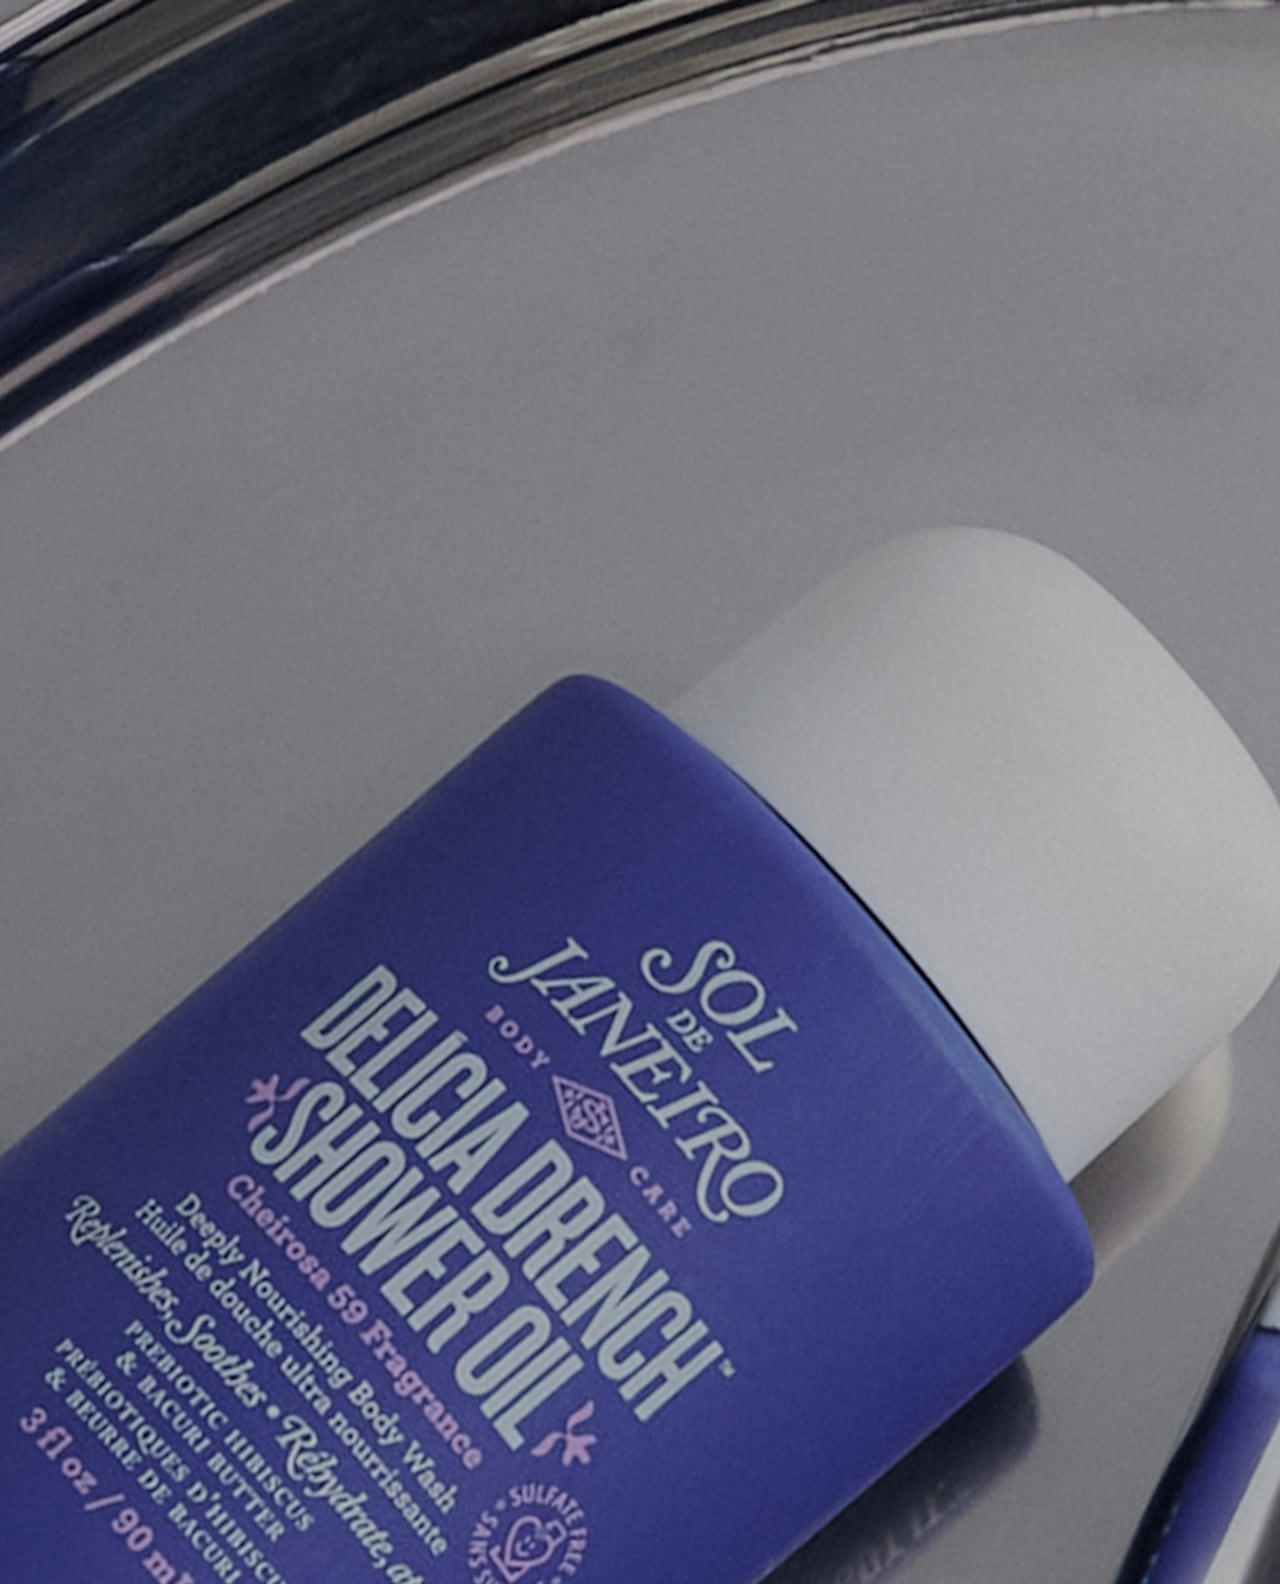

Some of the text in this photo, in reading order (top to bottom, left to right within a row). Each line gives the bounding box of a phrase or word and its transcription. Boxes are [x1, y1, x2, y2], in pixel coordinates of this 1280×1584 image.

[487, 937, 784, 1222] JANEIRO
[640, 940, 798, 1073] SOL
[666, 1008, 714, 1053] DE
[484, 1004, 692, 1238] BODY CARE
[175, 1192, 458, 1514] Deeply Nourishing Body Wash
[227, 1174, 482, 1470] Cheirosa 59 Fragrance
[250, 1080, 585, 1451] SHOWER OIL
[20, 1407, 48, 1433] 3
[36, 1426, 73, 1460] fl
[61, 1457, 98, 1495] oz
[111, 1507, 154, 1552] 90
[65, 1195, 179, 1321] Replenishes,
[164, 1313, 269, 1409] Soothes
[275, 1414, 394, 1569] Rehydrate,
[124, 1319, 315, 1532] PREBIOTIC HIBISCUS
[134, 1198, 447, 1556] Huile de douche ultra nourrissante
[136, 1374, 211, 1454] BACURI
[206, 1451, 285, 1542] BUTTER
[65, 1389, 142, 1471] BEURRE
[137, 1468, 172, 1505] DE
[167, 1502, 242, 1584] BACURI
[467, 1510, 499, 1569] SANS
[508, 1482, 588, 1577] SULFATE FREE
